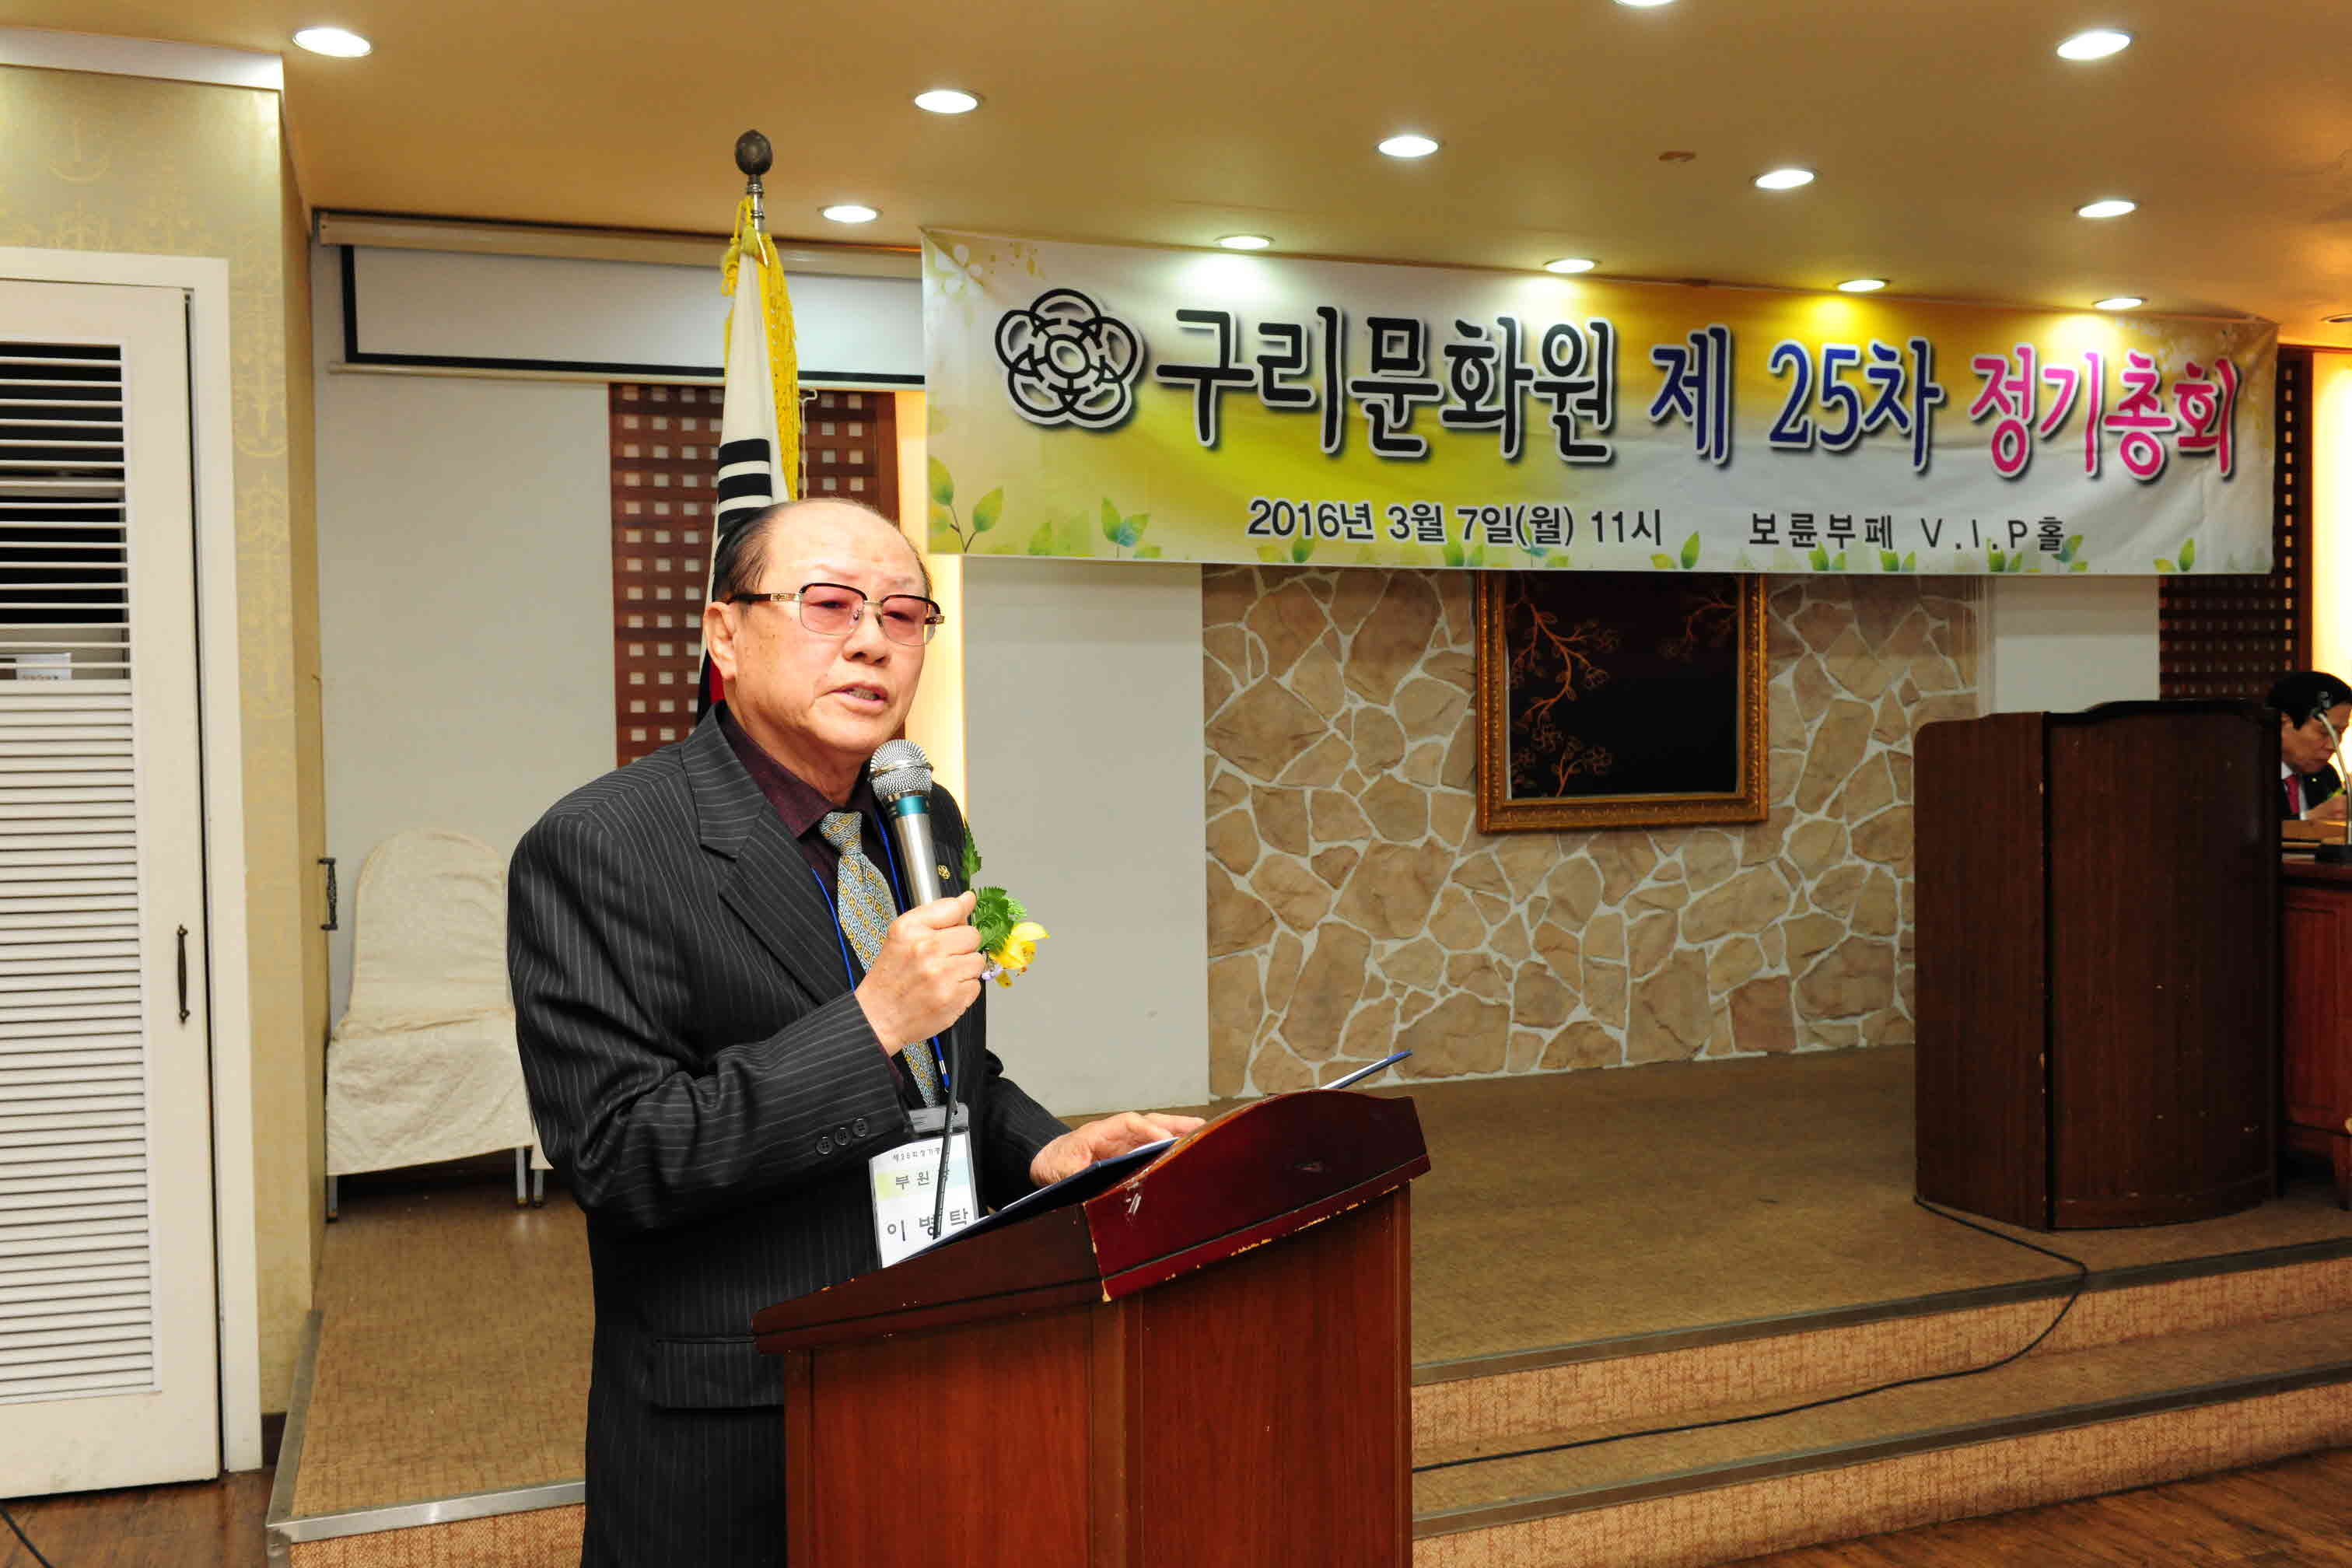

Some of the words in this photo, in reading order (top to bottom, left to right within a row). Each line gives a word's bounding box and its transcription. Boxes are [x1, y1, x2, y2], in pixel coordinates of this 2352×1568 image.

[1156, 306, 1611, 461] 구리문화원
[1650, 325, 1728, 464] 제
[1769, 338, 1943, 471] 25차
[1970, 345, 2238, 478] 정기총회
[1248, 499, 1375, 541] 2016년
[1388, 503, 1446, 543] 3월
[1457, 506, 1574, 547] 7일(월)
[1591, 509, 1662, 547] 11시
[1749, 513, 1893, 551] 보륜부페
[1920, 516, 2065, 551] V.I.P홀
